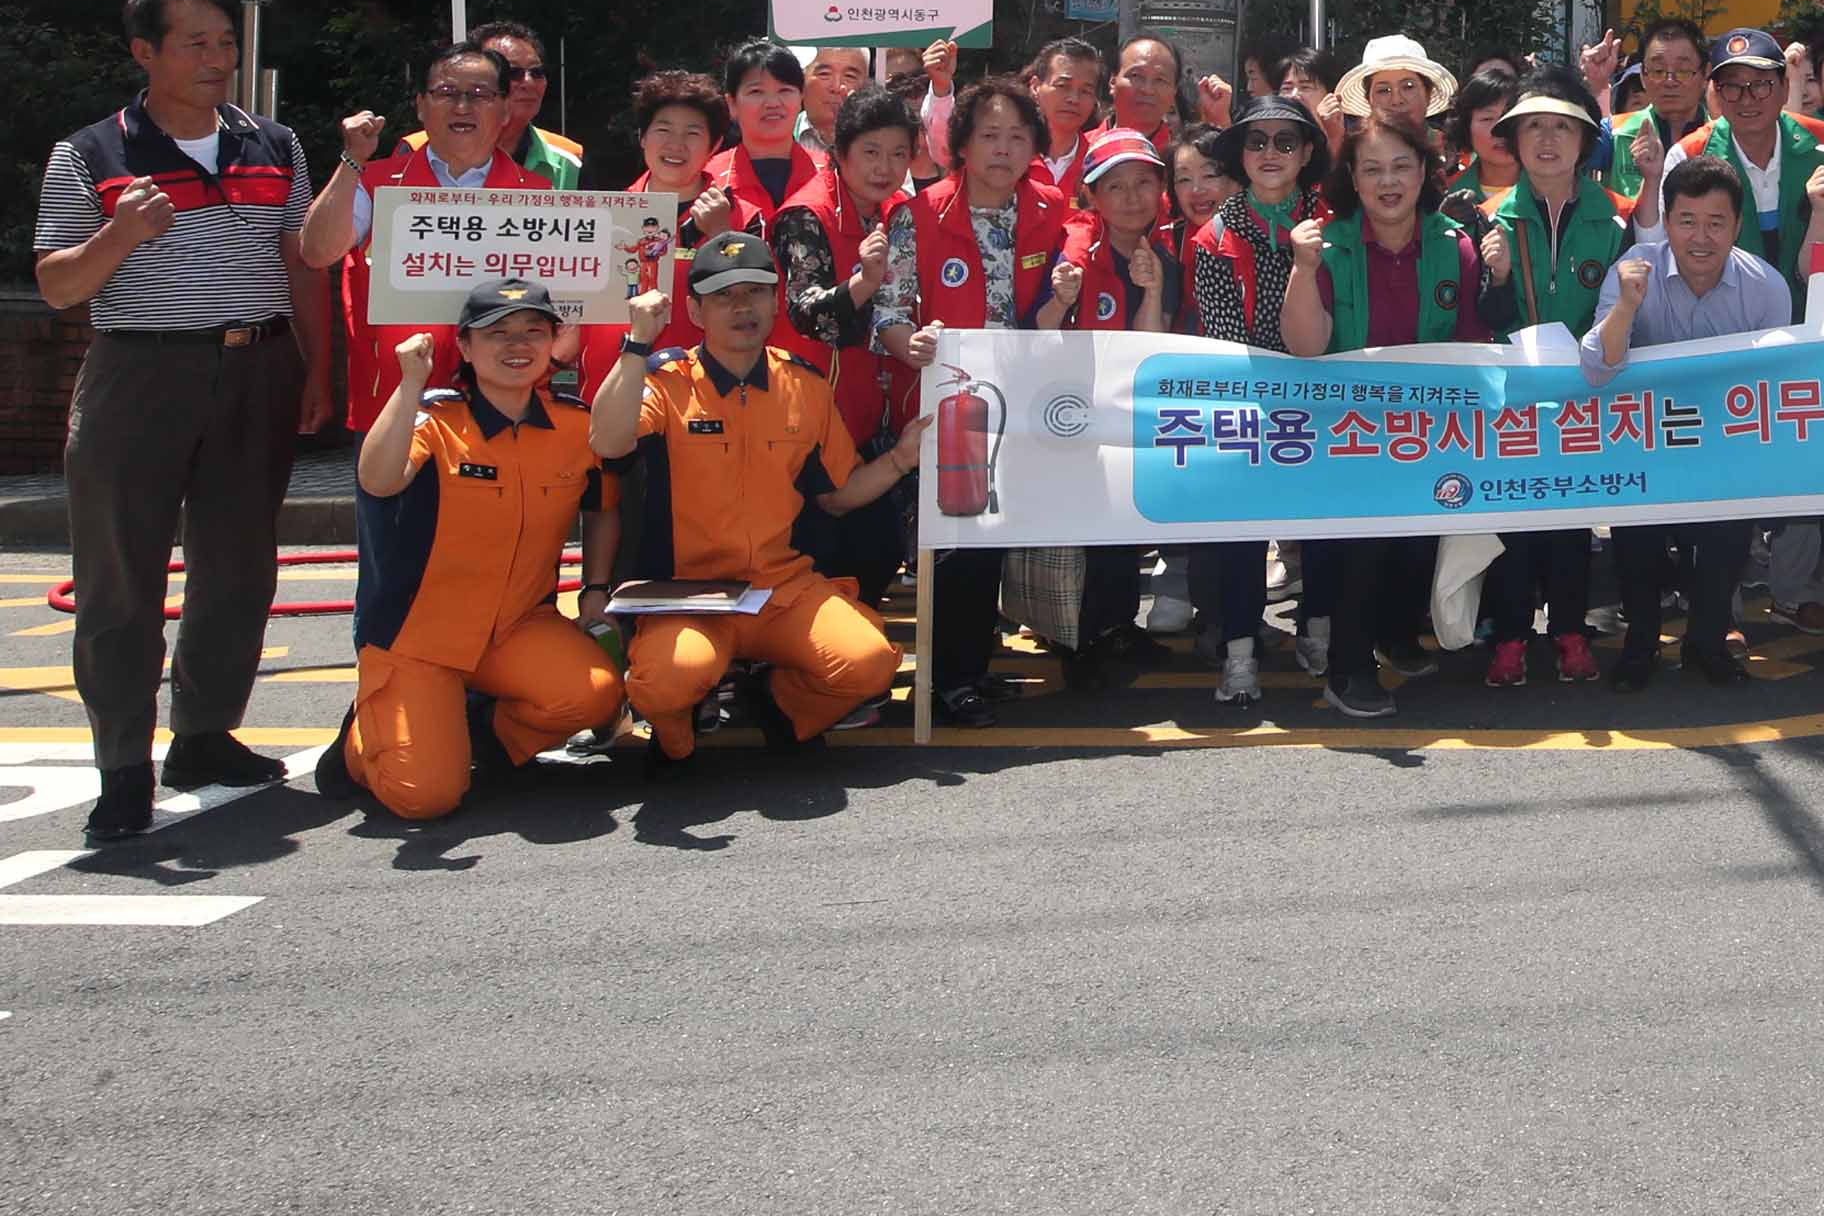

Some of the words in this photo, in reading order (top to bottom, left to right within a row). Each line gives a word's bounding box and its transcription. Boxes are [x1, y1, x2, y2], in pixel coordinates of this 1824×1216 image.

[847, 7, 940, 22] 인천광역시동구
[487, 192, 514, 206] 우리
[517, 193, 555, 208] 가정의
[559, 194, 596, 208] 행복을
[601, 195, 649, 209] 지켜주는
[409, 215, 488, 242] 주택용
[496, 217, 597, 243] 소방시설
[402, 252, 476, 277] 설치는
[484, 252, 601, 278] 의무입니다
[1158, 379, 1248, 399] 화재로부터
[1252, 381, 1288, 400] 우리
[1293, 382, 1345, 401] 가정의
[1351, 384, 1405, 404] 행복을
[1408, 386, 1481, 406] 지켜주는
[1154, 406, 1318, 467] 주택용
[1327, 403, 1542, 463] 소방시설
[1553, 388, 1703, 456] 설치는
[1479, 472, 1648, 502] 인천중부소방서
